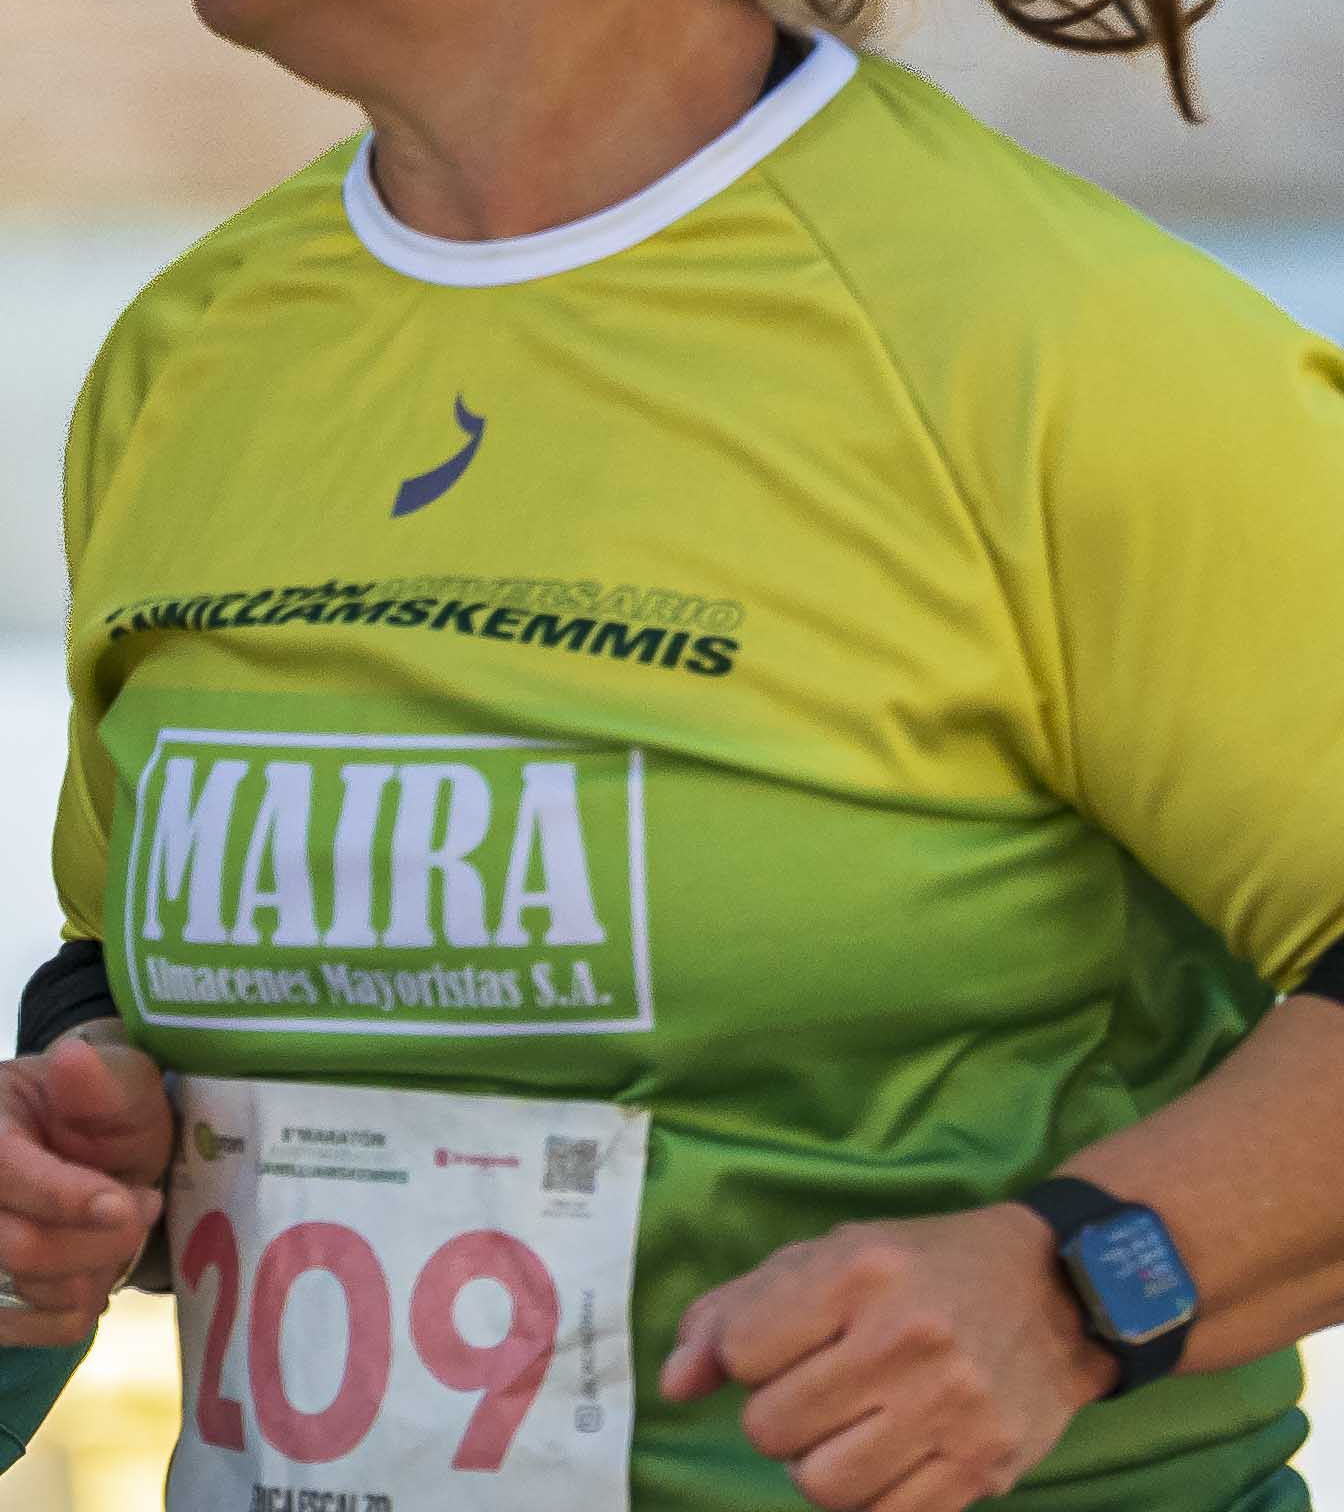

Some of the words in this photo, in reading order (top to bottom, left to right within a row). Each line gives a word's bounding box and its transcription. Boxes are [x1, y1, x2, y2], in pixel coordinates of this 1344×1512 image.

[143, 755, 608, 948] MAIRA
[320, 962, 523, 1012] Mayoristas
[179, 1209, 562, 1473] 209
